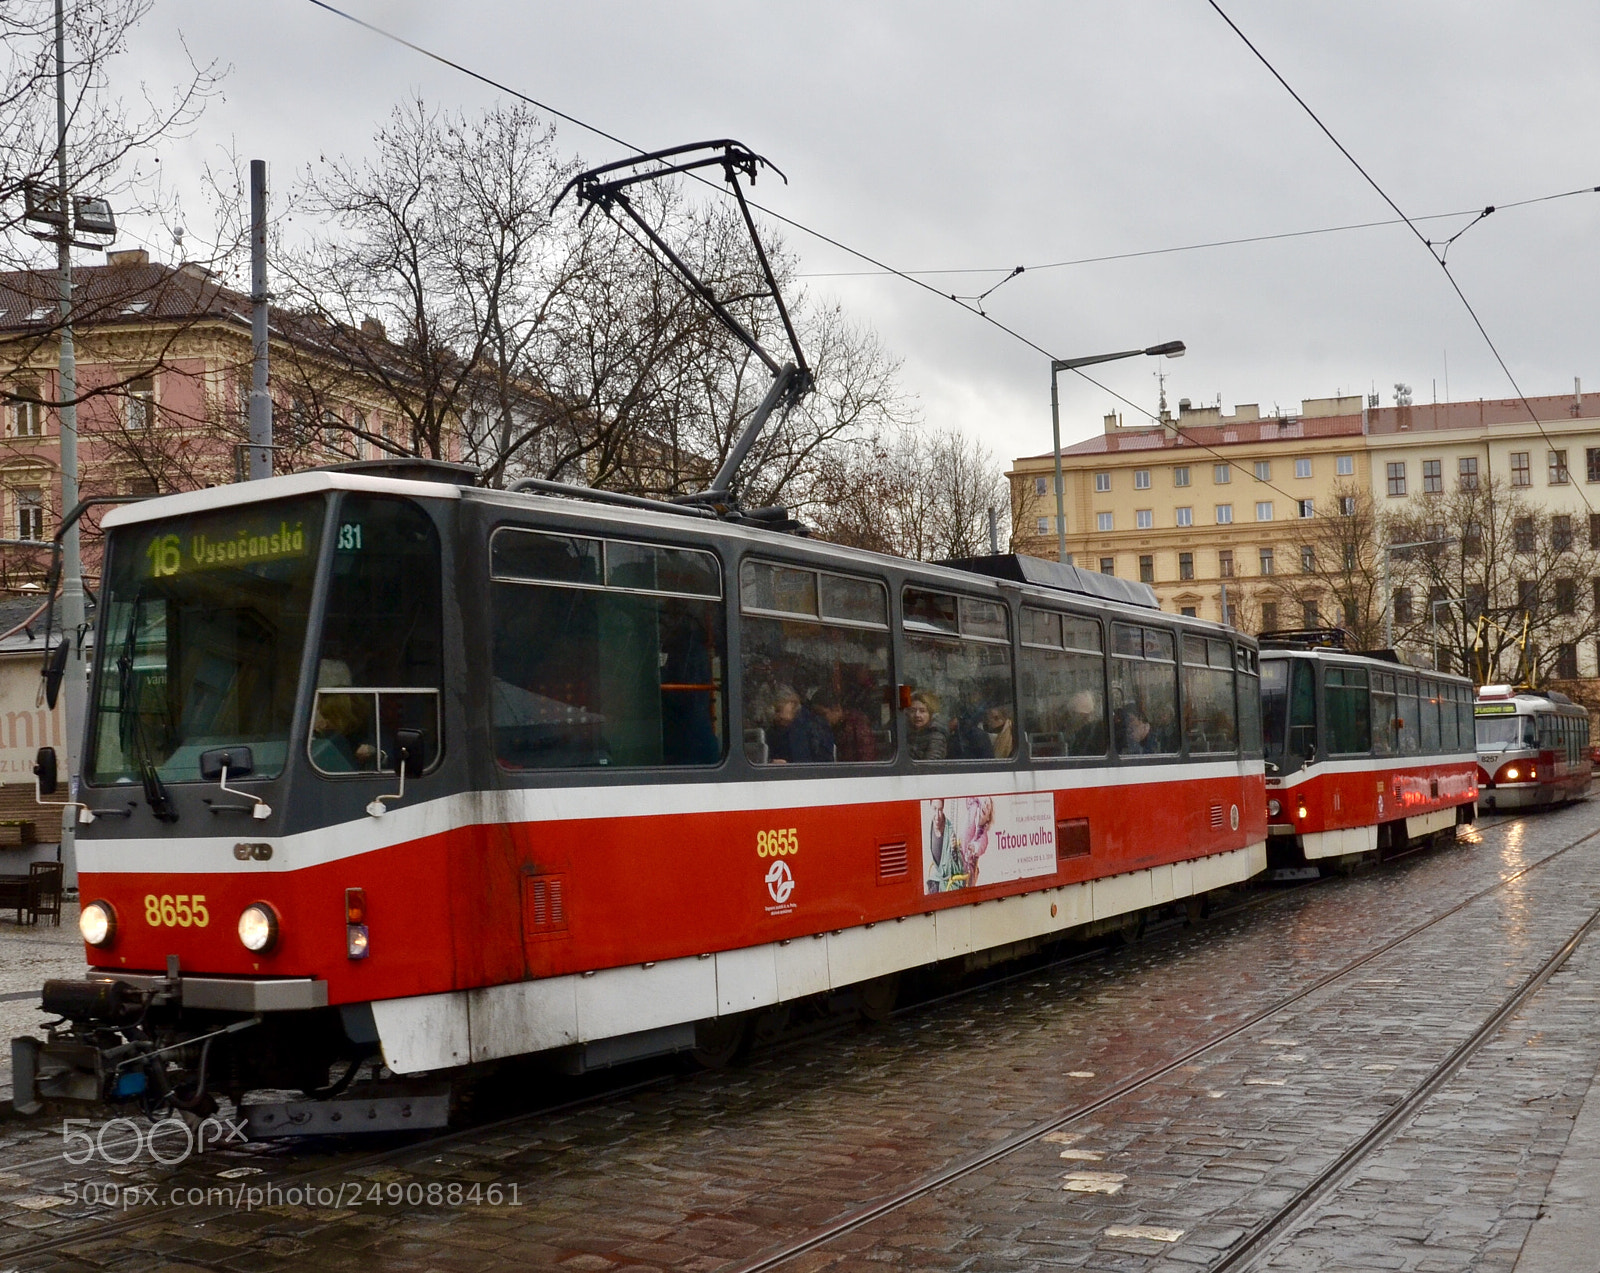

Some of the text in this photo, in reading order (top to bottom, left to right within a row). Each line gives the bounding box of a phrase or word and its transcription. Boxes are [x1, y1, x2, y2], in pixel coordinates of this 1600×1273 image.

[148, 534, 181, 577] 16
[757, 828, 799, 858] 8655
[1029, 826, 1053, 846] volha
[144, 894, 210, 928] 8655
